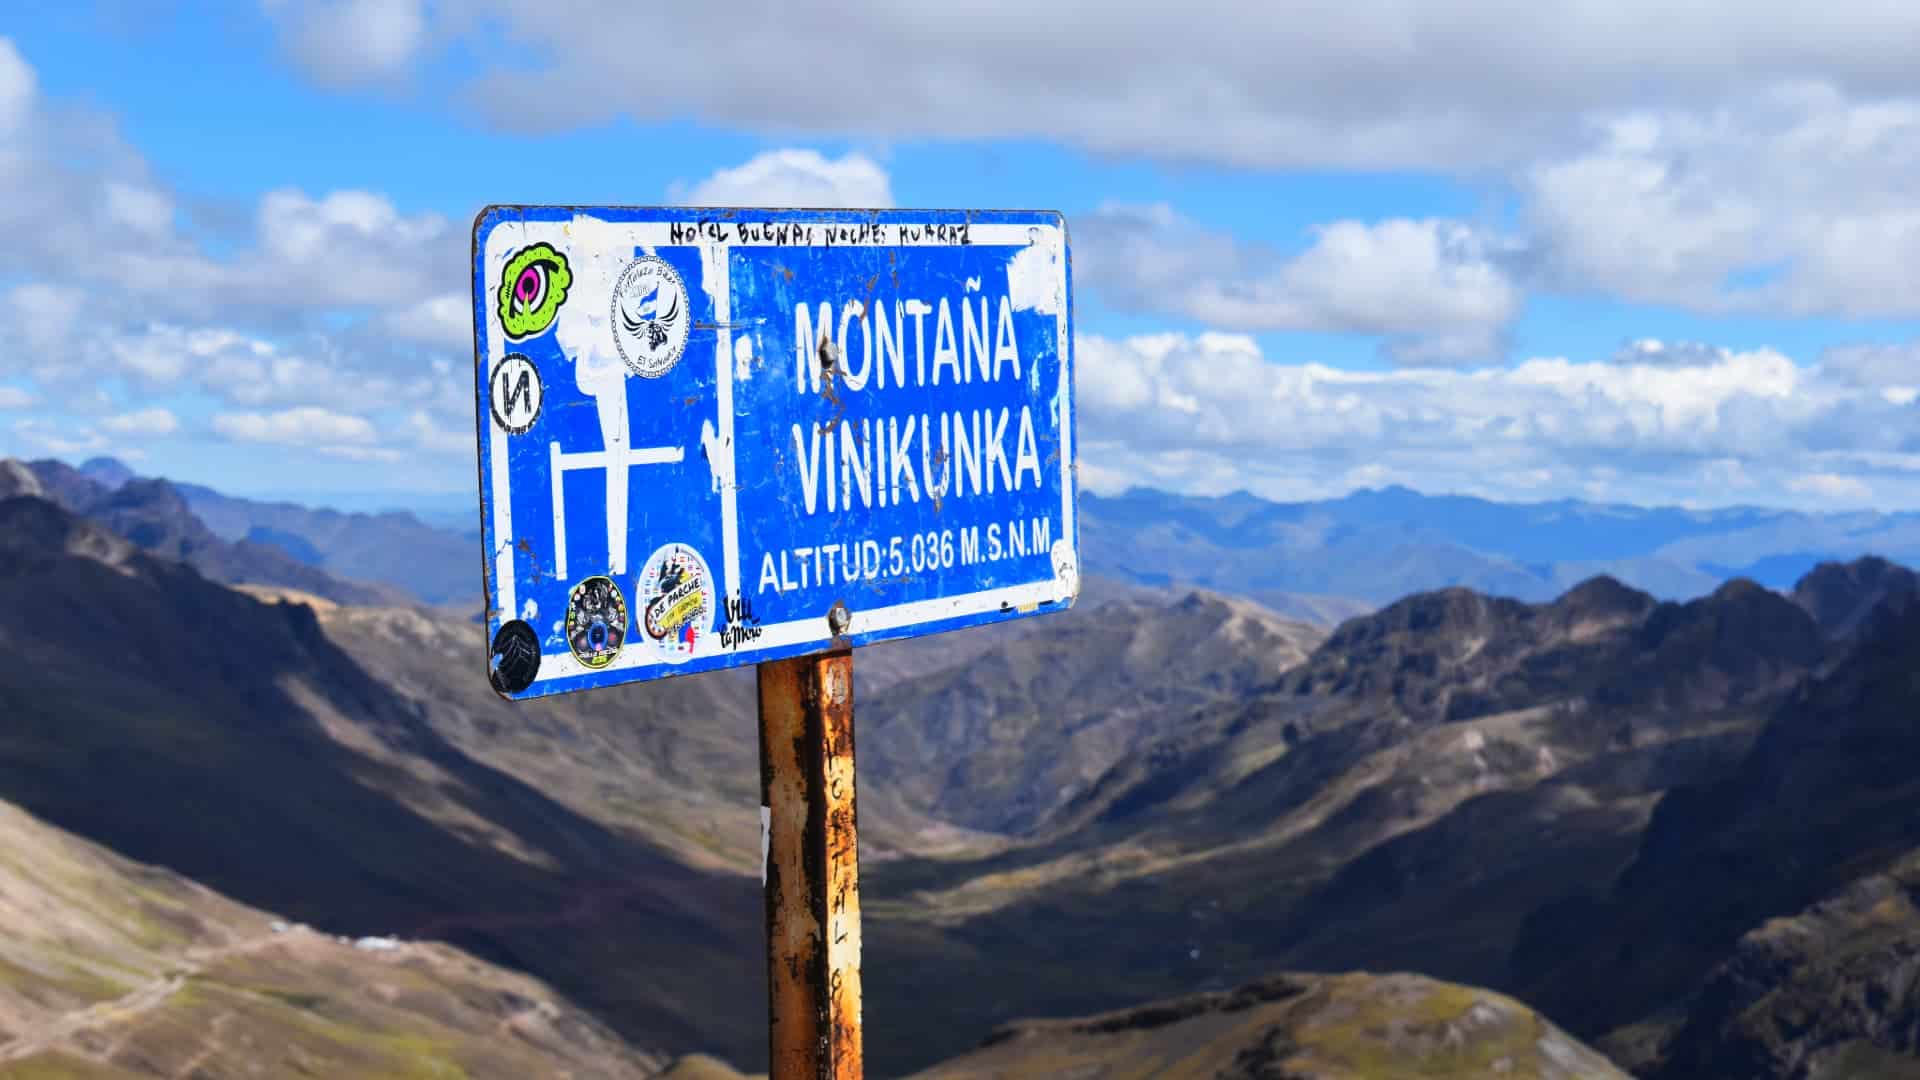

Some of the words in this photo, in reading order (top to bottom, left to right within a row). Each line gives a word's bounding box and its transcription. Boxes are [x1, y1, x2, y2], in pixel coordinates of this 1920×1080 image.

[795, 276, 1021, 395] MONTAÑA
[792, 405, 1042, 515] VINIKUNKA
[654, 603, 666, 619] DE
[668, 577, 700, 606] PARCHE
